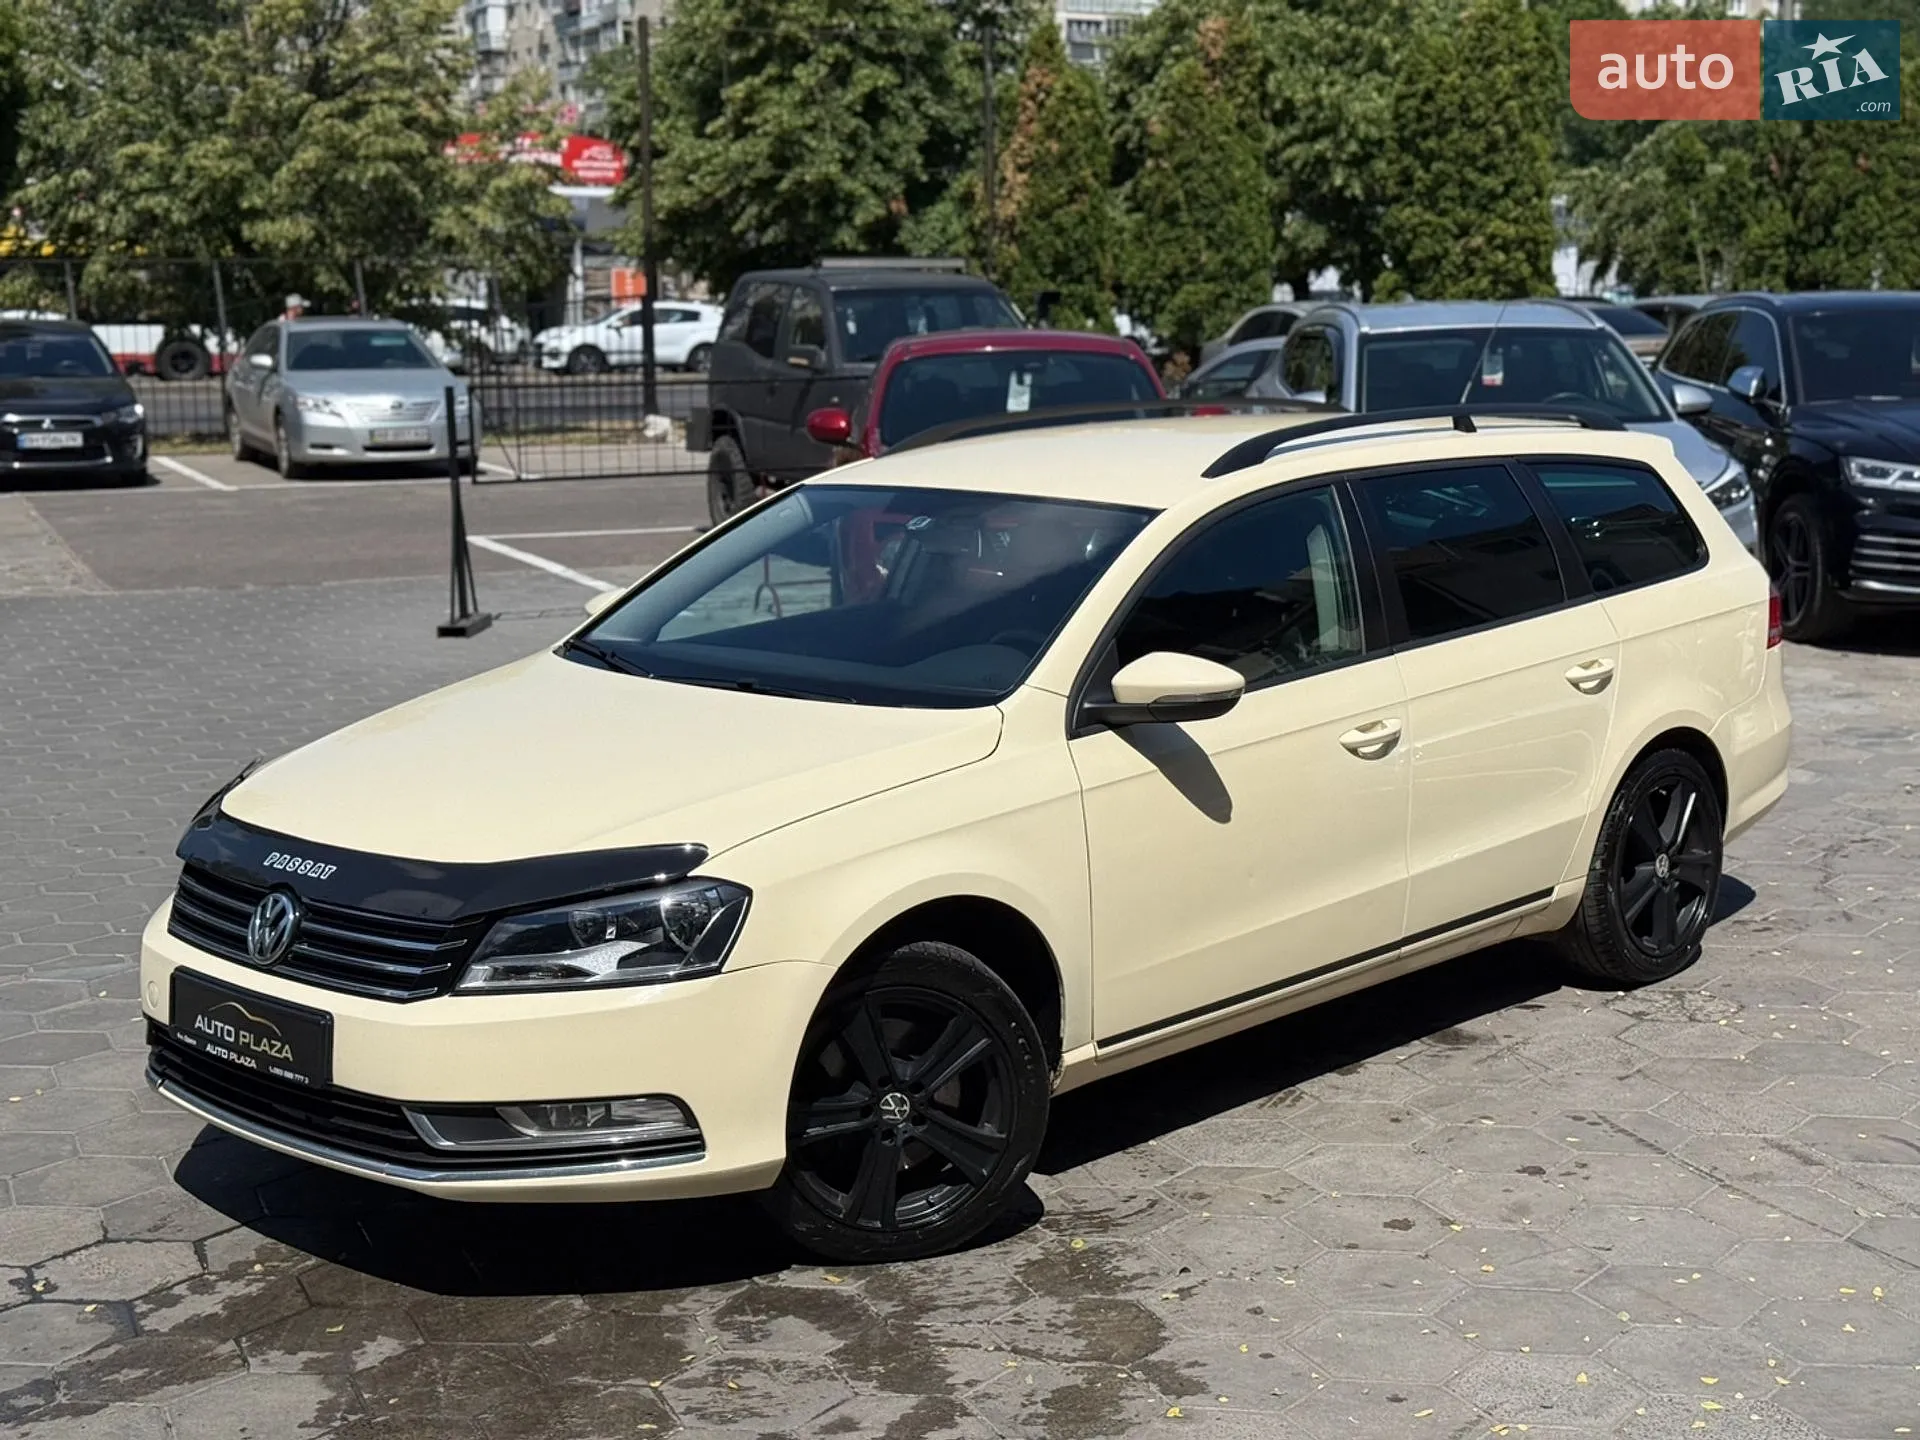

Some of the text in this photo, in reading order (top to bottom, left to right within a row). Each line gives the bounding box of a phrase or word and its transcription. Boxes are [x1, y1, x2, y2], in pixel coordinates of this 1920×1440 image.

[263, 852, 337, 879] PASSAT
[194, 1014, 235, 1042] AUTO
[239, 1030, 293, 1062] PLAZA
[205, 1043, 257, 1069] AUTO PLAZA
